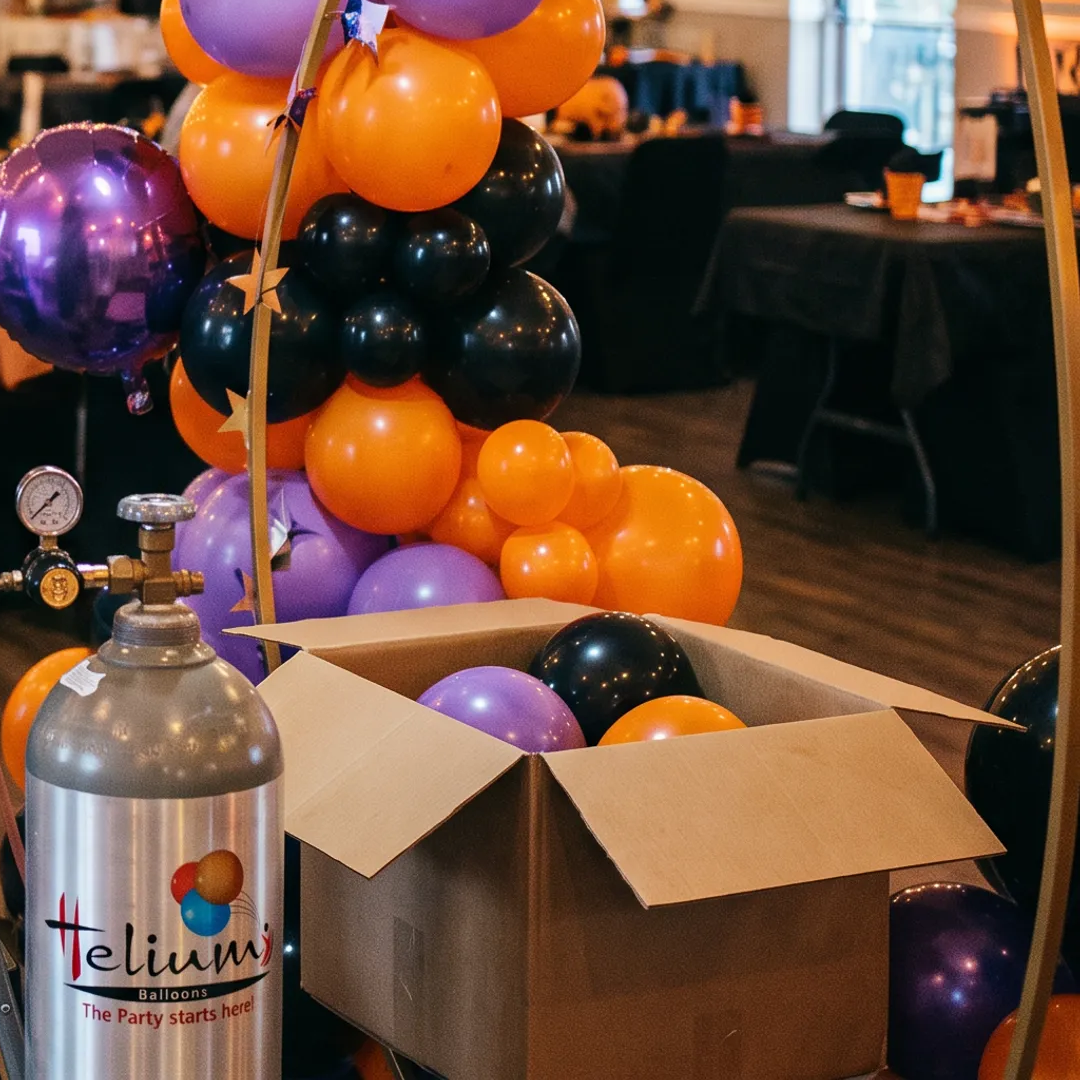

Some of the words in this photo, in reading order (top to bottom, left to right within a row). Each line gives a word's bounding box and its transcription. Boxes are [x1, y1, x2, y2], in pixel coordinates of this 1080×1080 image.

[45, 892, 264, 981] Helium
[139, 987, 208, 1001] Balloons
[83, 1003, 111, 1023] The
[118, 1008, 164, 1029] Party
[170, 1008, 217, 1025] starts
[222, 996, 255, 1018] here!
